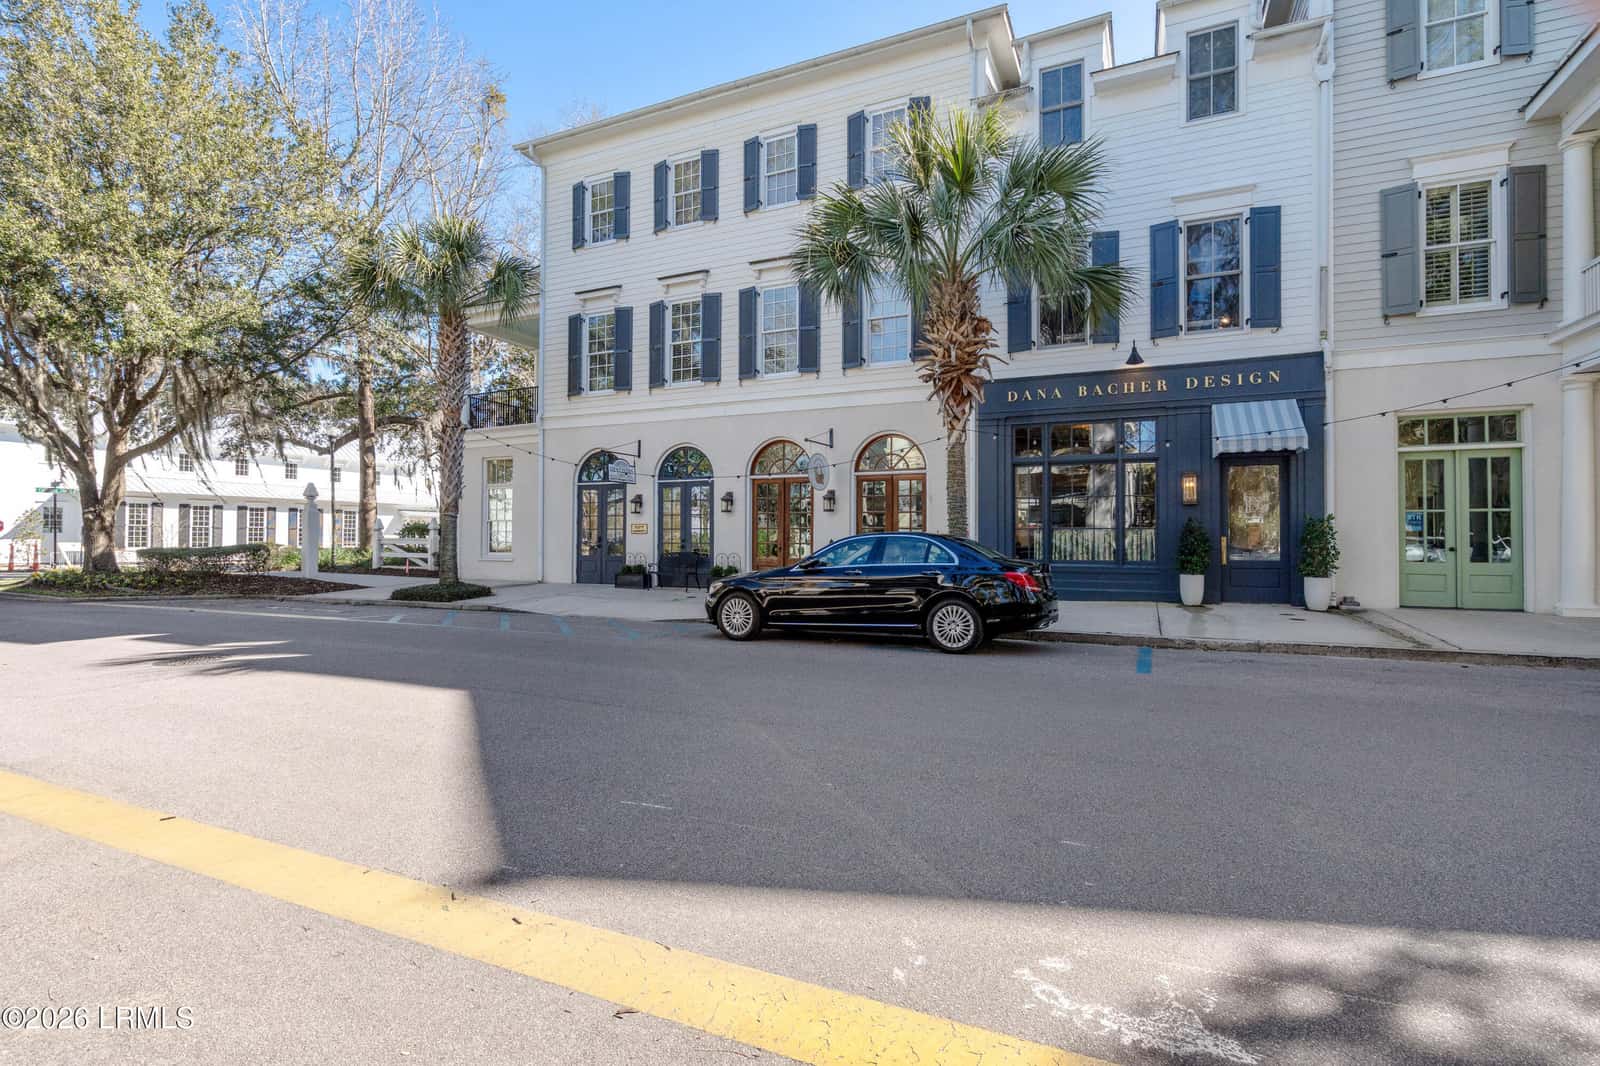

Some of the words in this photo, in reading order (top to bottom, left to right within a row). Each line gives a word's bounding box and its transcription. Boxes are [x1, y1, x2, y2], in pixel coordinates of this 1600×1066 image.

[1008, 387, 1062, 402] DANA
[1078, 379, 1168, 397] BACHER
[1186, 370, 1281, 390] DESIGN
